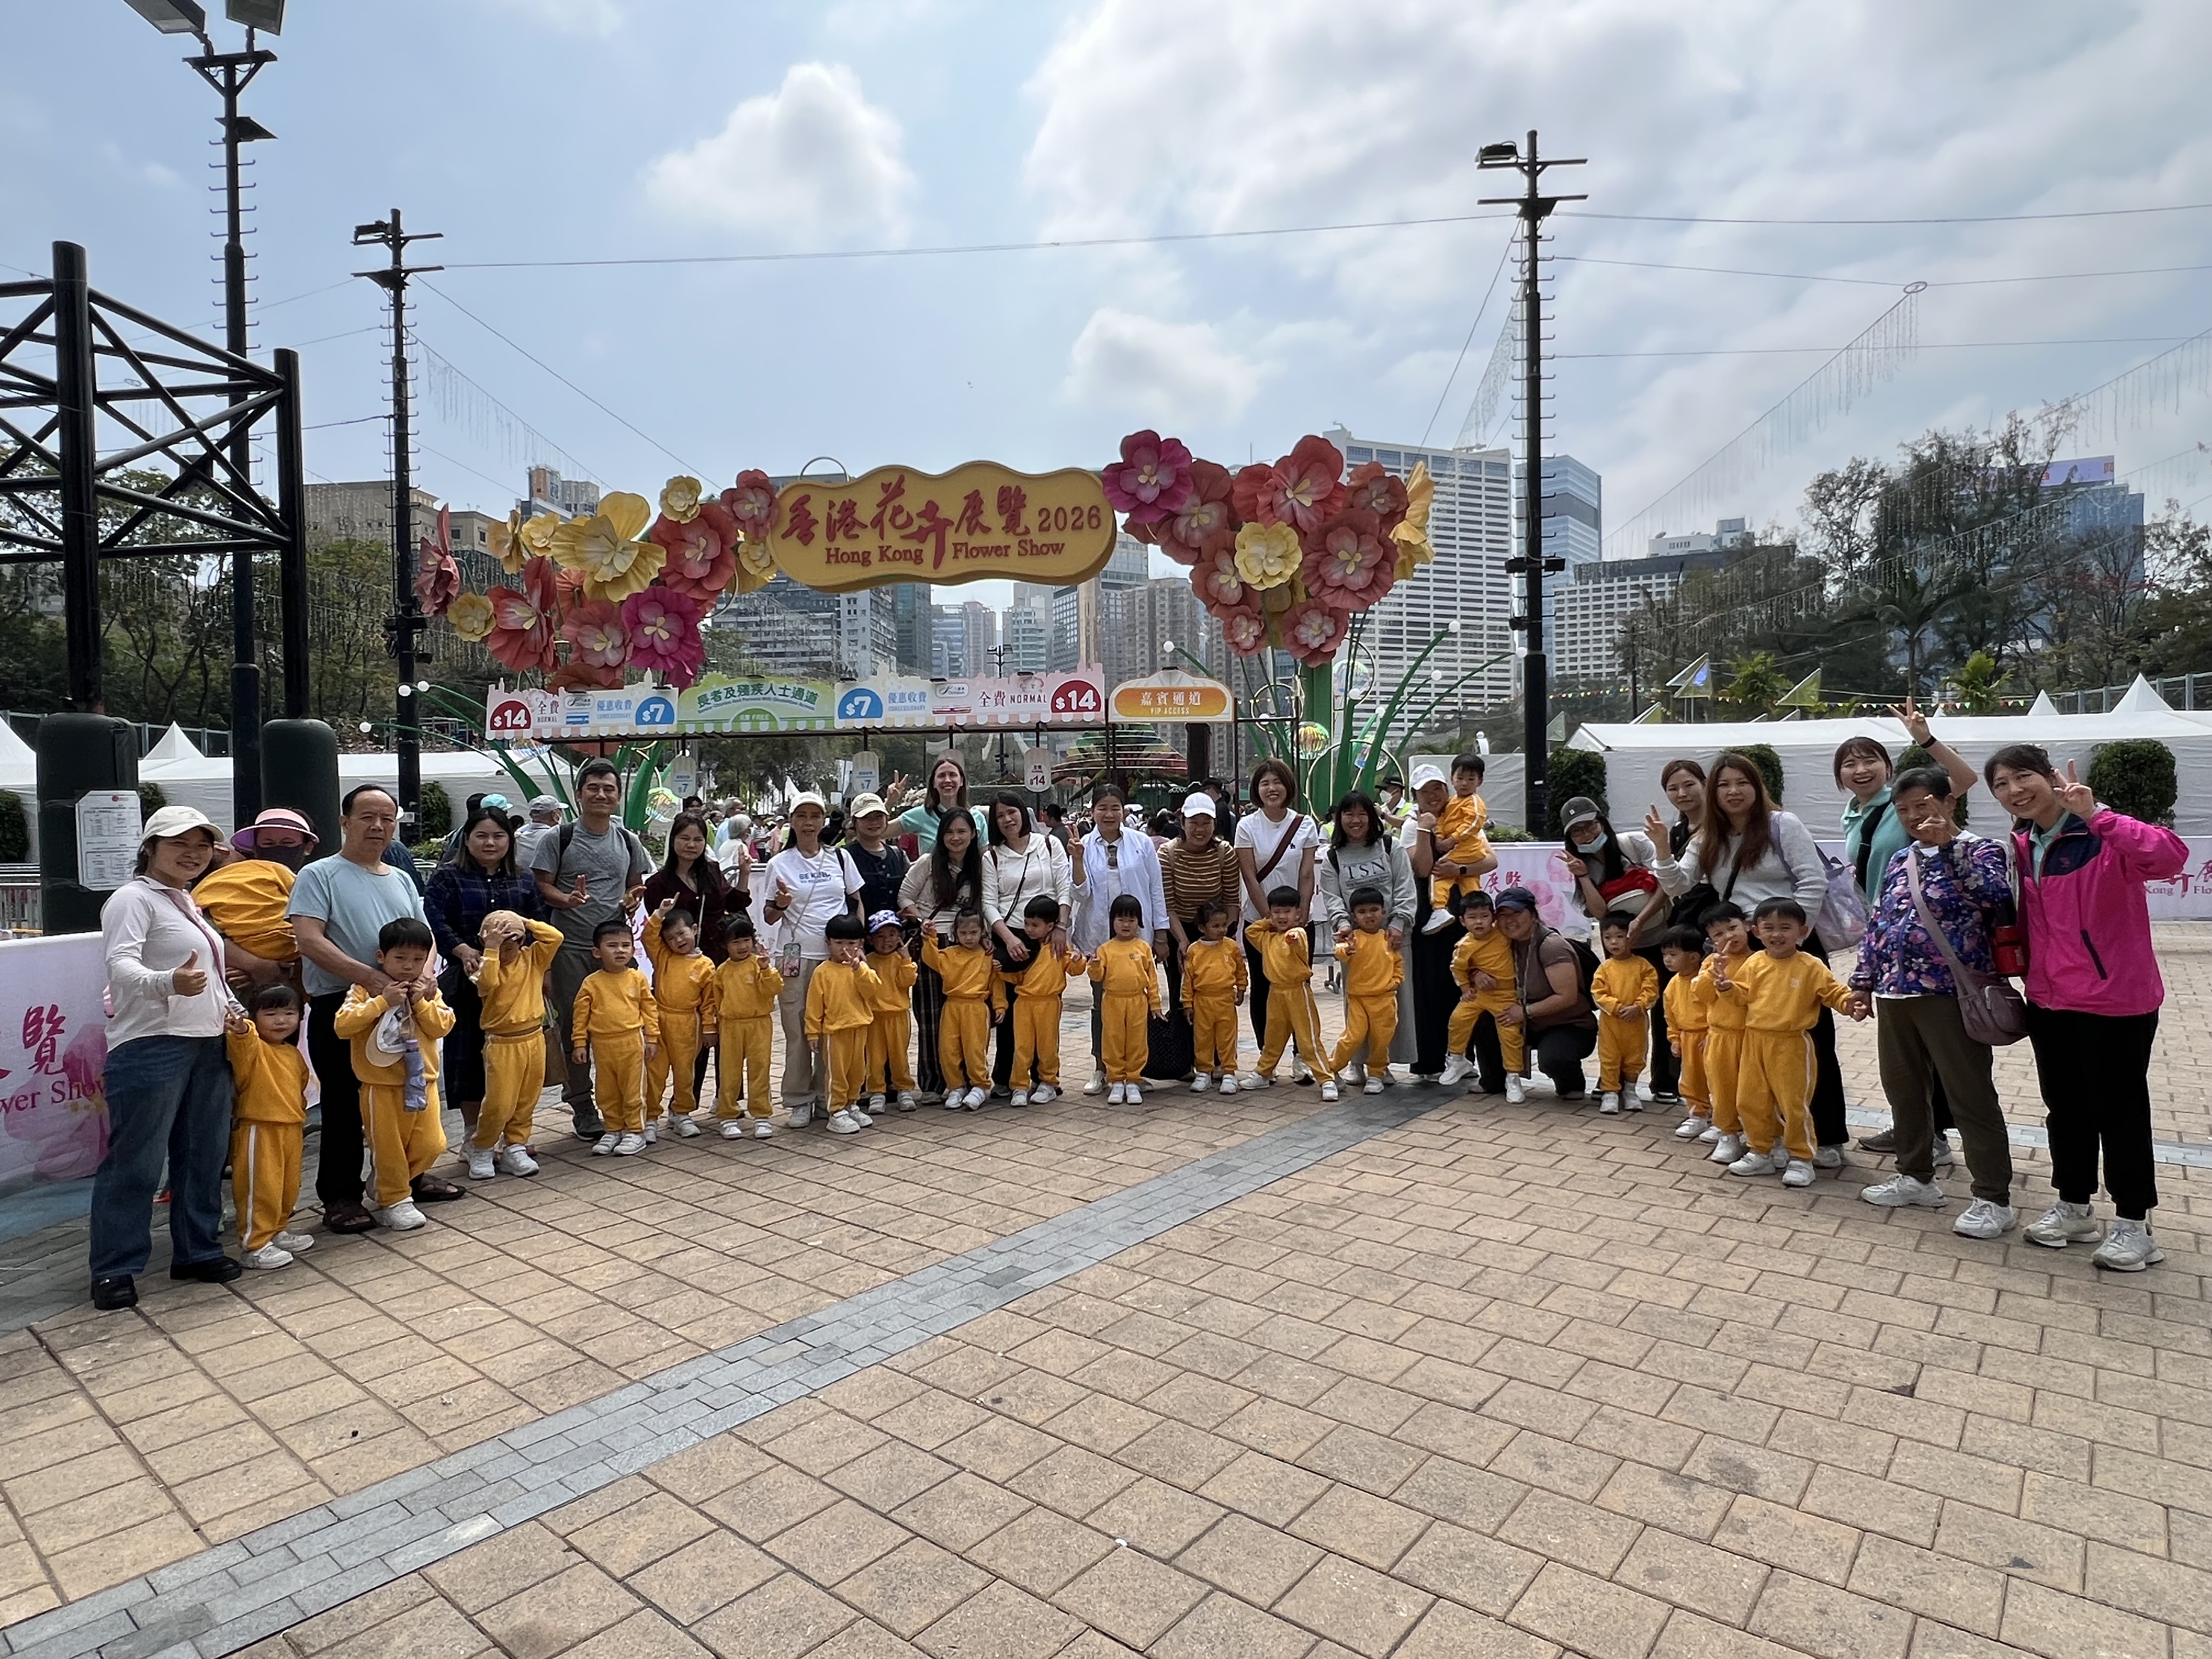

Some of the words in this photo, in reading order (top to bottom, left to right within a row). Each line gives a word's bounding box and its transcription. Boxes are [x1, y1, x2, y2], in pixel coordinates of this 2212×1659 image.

[781, 475, 1030, 570] 香港花卉展覽
[1038, 506, 1102, 532] 2026
[825, 548, 871, 566] Hong
[878, 546, 924, 565] Kong
[952, 542, 1010, 559] Flower
[1017, 539, 1065, 556] Show
[697, 682, 819, 709] 長者及殘疾人士通道
[979, 691, 1006, 708] 全費
[1010, 693, 1047, 704] NORMAL
[1056, 690, 1097, 710] $14
[1140, 691, 1201, 706] 嘉賓通道
[537, 700, 560, 715] 全費
[642, 704, 665, 723] $7
[846, 696, 871, 716] $7
[494, 709, 527, 728] $14
[1343, 856, 1385, 879] TSN
